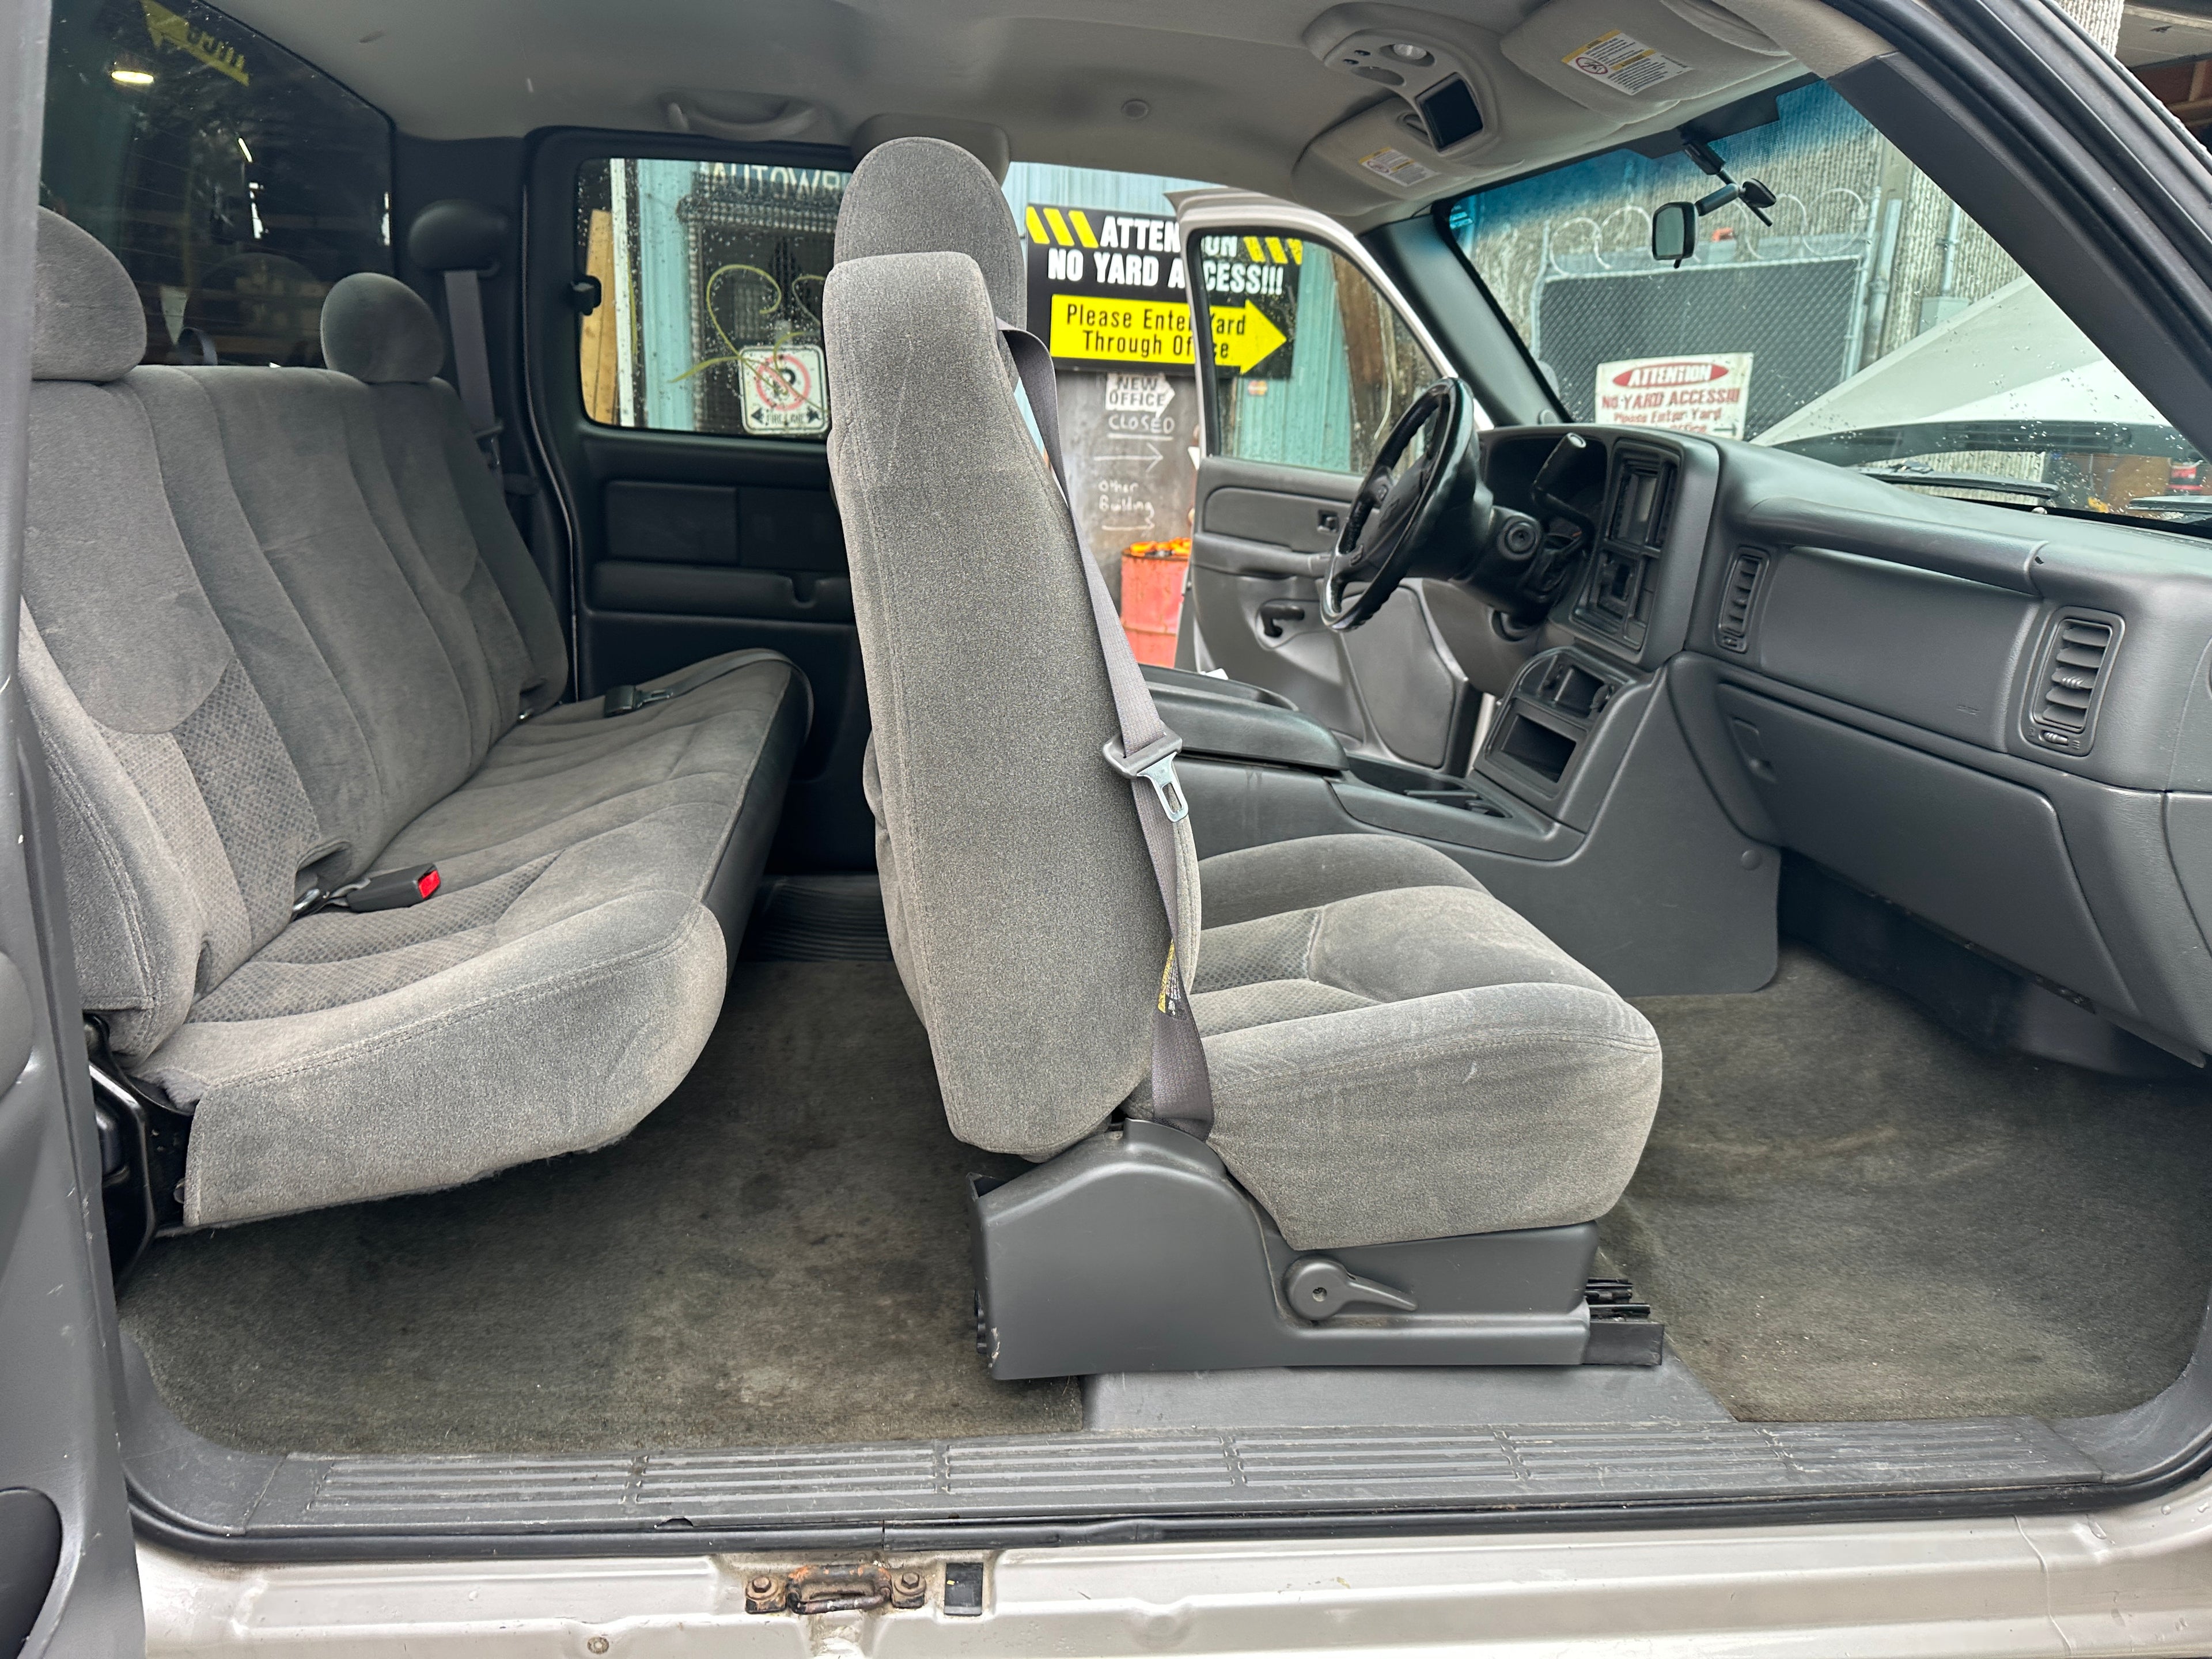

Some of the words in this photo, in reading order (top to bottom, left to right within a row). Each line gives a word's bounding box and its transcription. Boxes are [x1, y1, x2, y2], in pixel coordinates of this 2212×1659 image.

[1100, 215, 1237, 257] ATTENON
[1048, 248, 1084, 281] NO
[1094, 252, 1159, 287] YARD
[1168, 257, 1284, 296] ACESS!!!
[1067, 304, 1132, 328] Please
[1082, 330, 1162, 358] Through
[1173, 334, 1229, 359] Ofe
[1112, 377, 1157, 390] NEW
[1627, 364, 1713, 388] ATTENTION
[1109, 389, 1165, 407] OFFICE
[1602, 395, 1619, 409] NO
[1624, 392, 1664, 410] YARD
[1108, 414, 1175, 434] CLOSED
[1691, 407, 1722, 421] Yard
